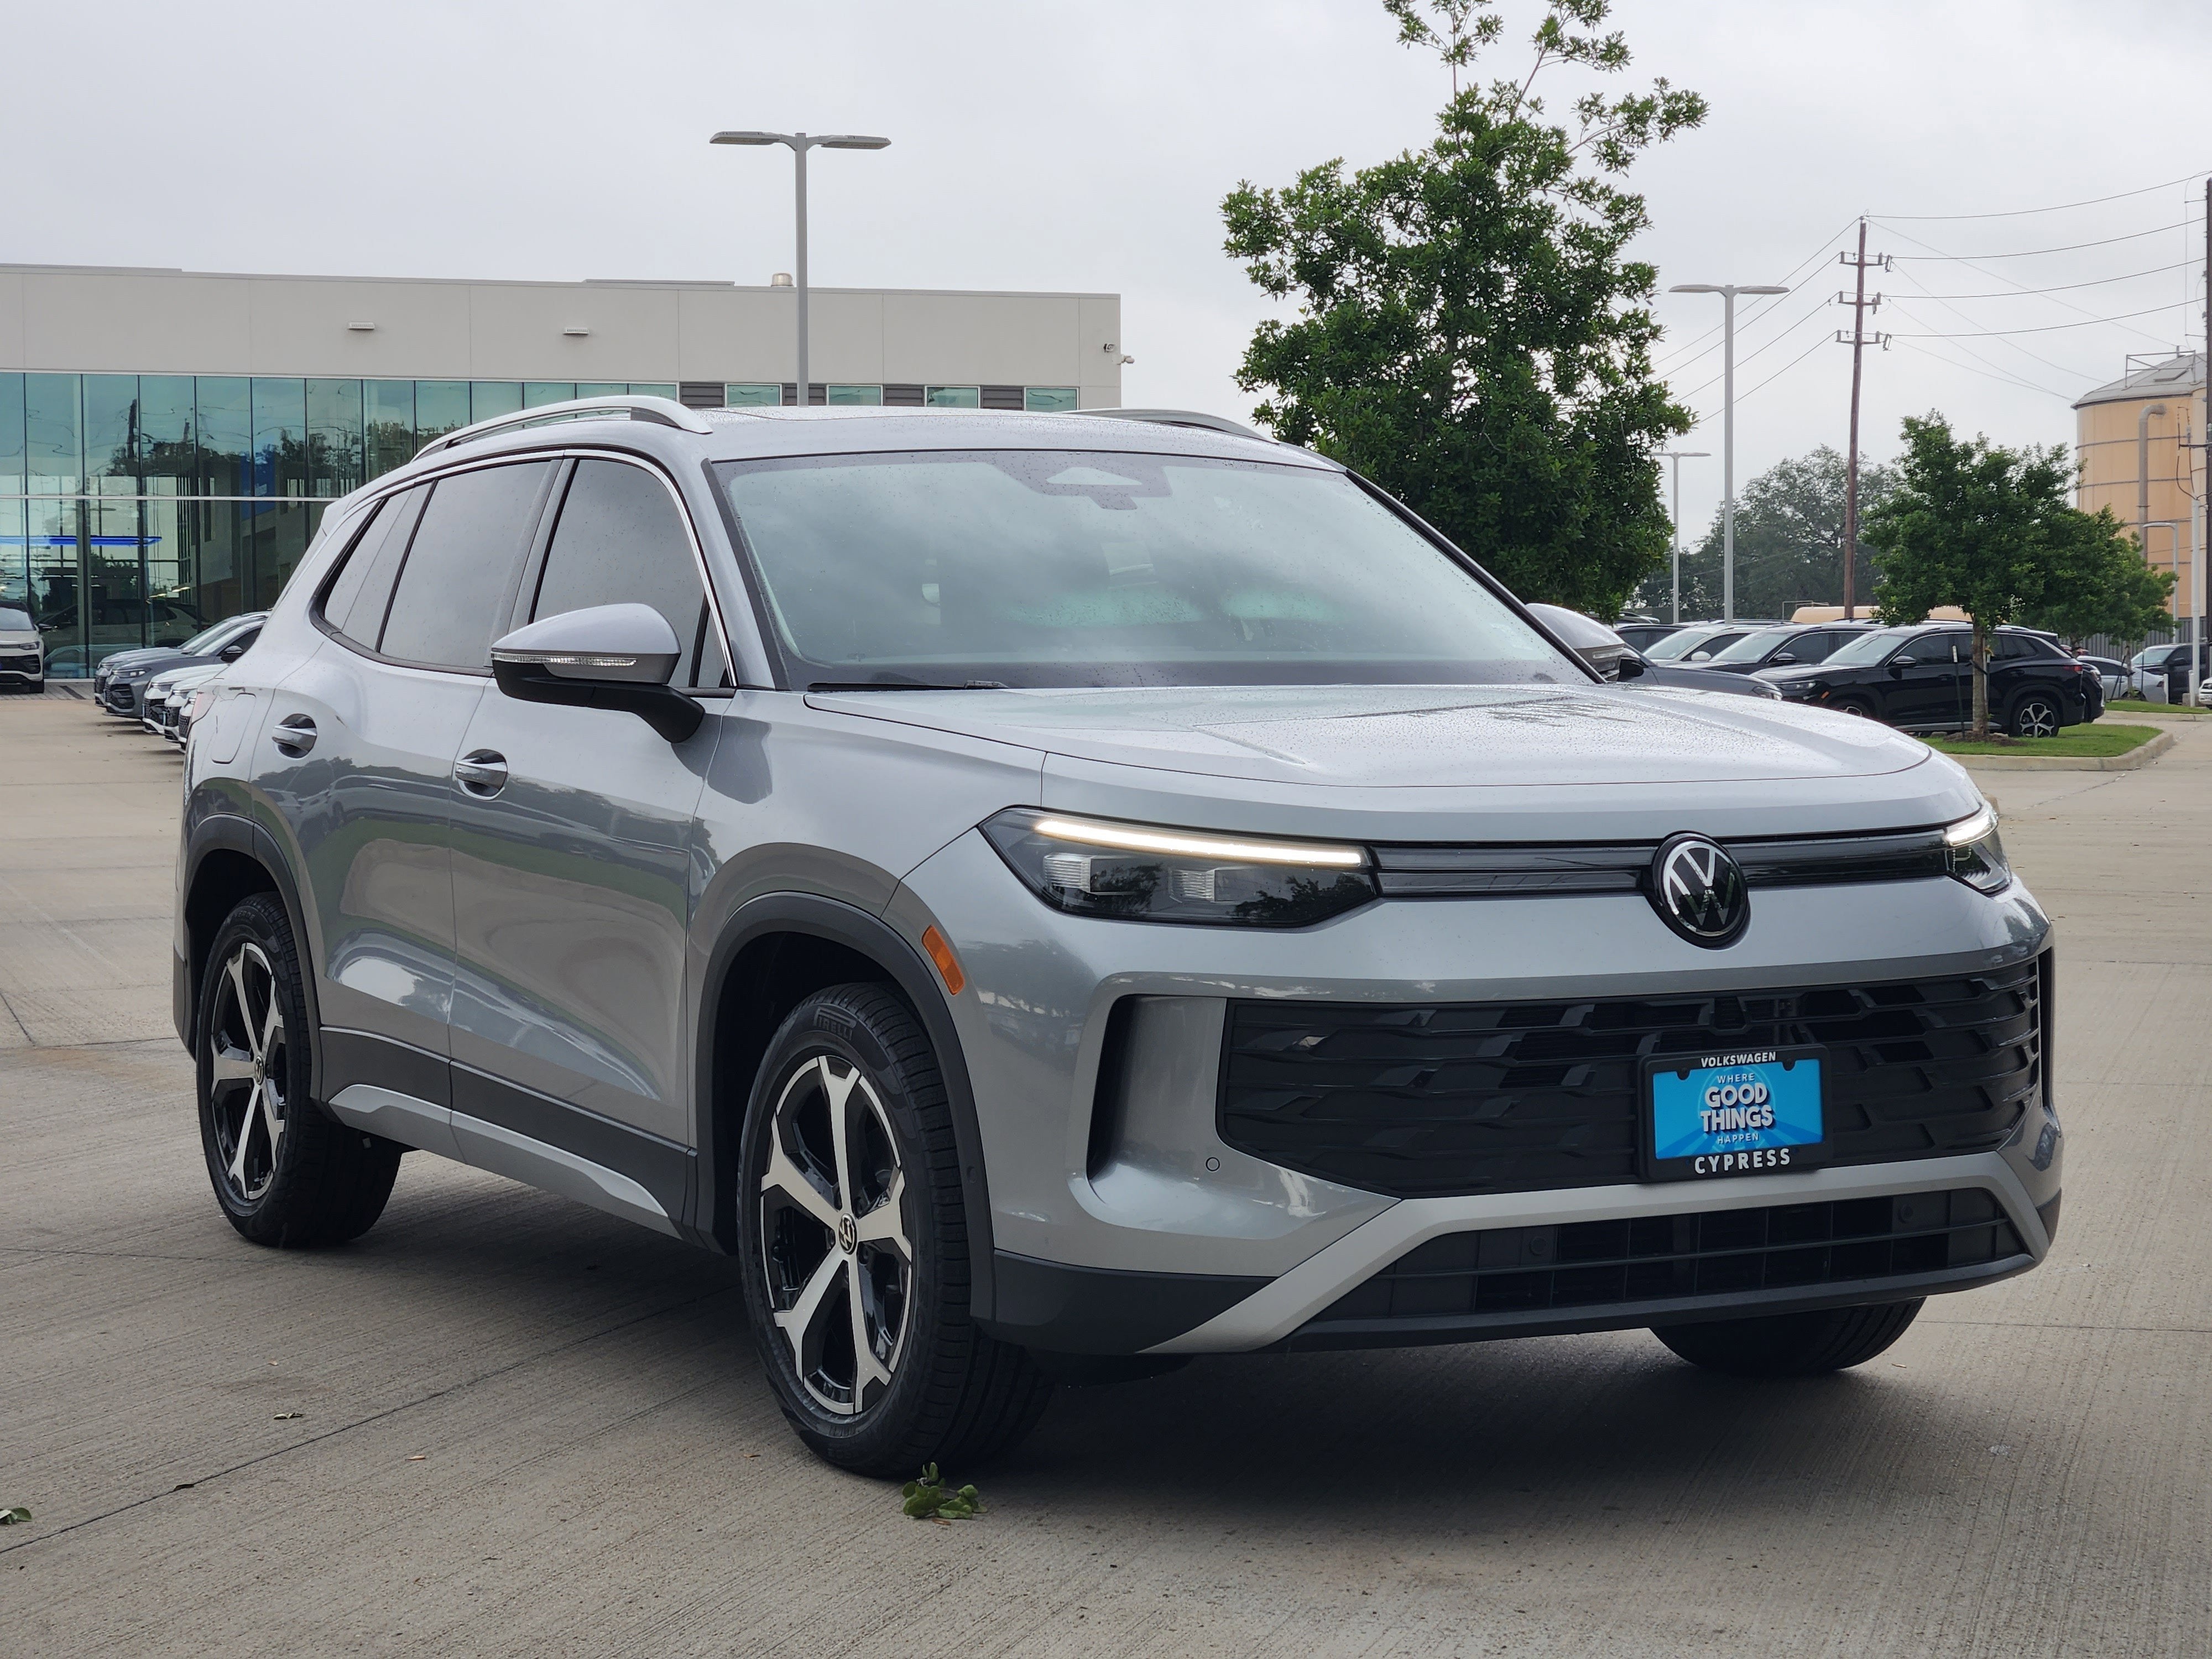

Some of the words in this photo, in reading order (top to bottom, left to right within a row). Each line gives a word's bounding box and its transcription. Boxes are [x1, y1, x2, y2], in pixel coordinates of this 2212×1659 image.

[813, 1006, 857, 1041] PIRELLI
[1700, 1051, 1777, 1068] VOLKSWAGEN
[1717, 1073, 1755, 1084] WHERE
[1705, 1082, 1768, 1108] GOOD
[1700, 1104, 1773, 1132] THINGS
[1717, 1133, 1759, 1145] HAPPEN
[1694, 1147, 1791, 1175] CYPRESS
